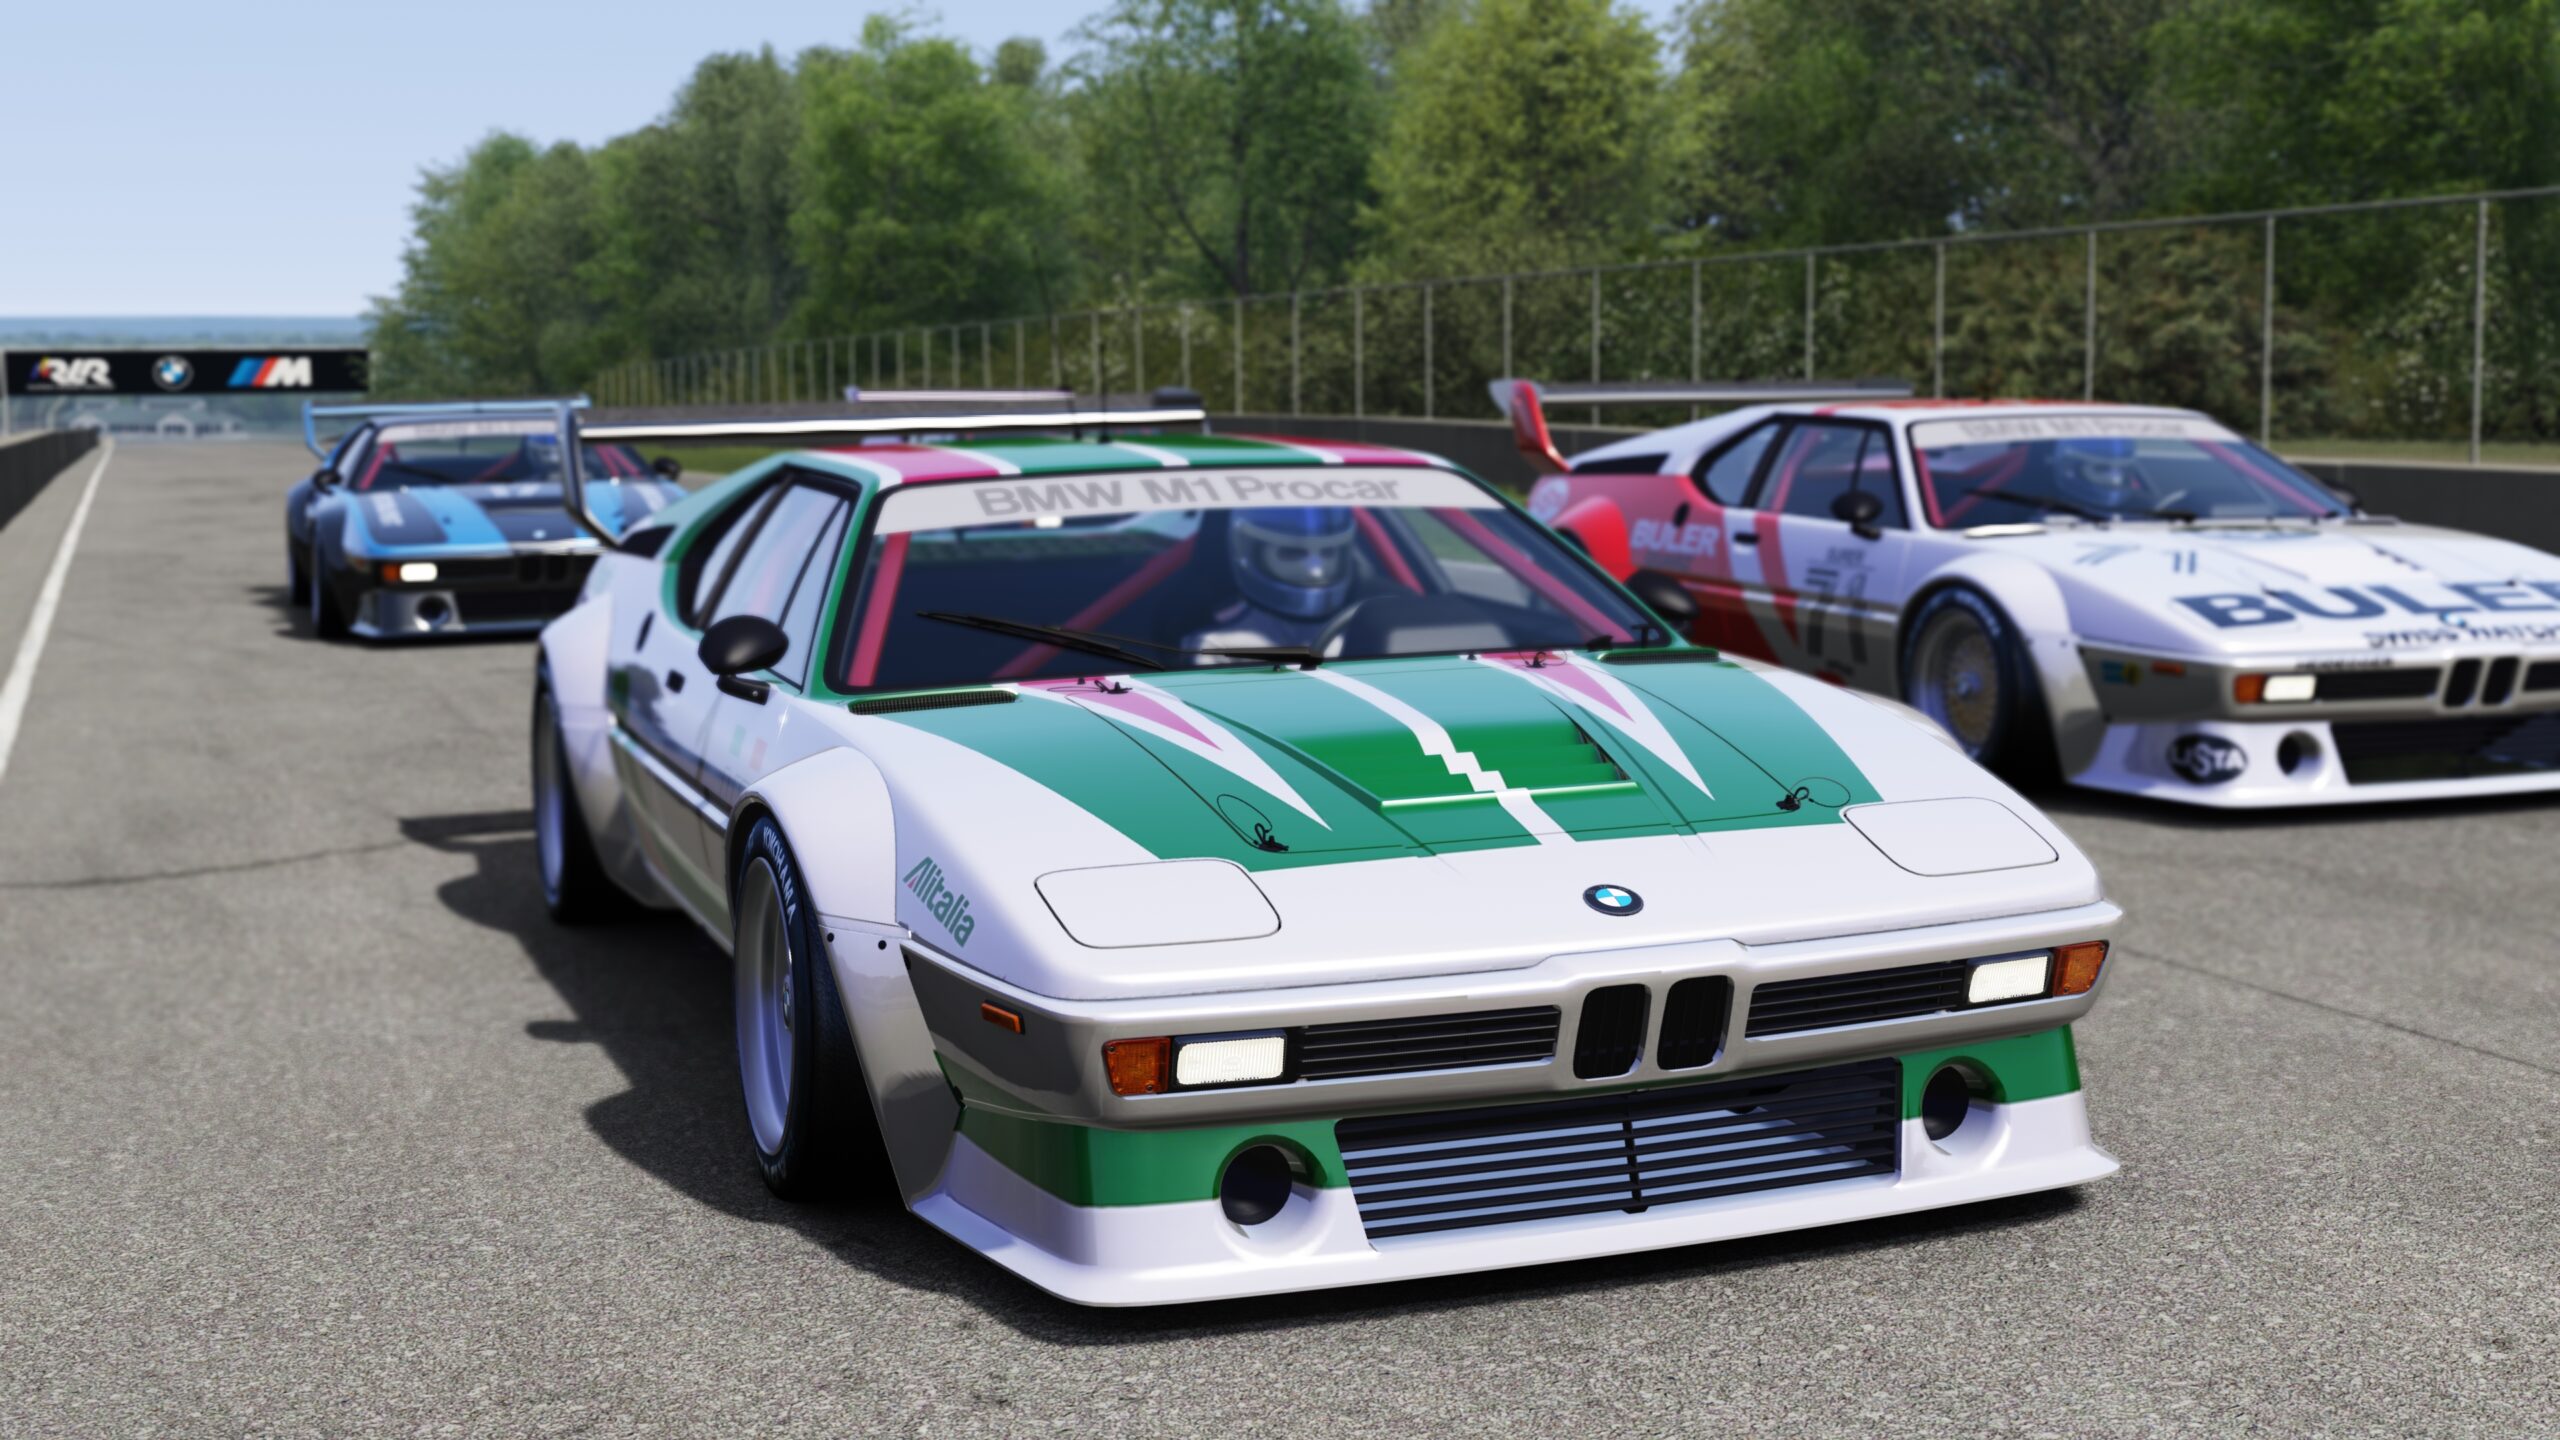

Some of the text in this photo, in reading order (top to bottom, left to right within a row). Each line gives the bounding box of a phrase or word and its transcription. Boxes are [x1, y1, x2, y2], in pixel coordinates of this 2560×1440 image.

[973, 476, 1398, 517] BMW M1 Procar
[1629, 518, 1720, 557] BULER
[763, 826, 797, 926] YOKOHAMA
[902, 856, 975, 948] Alitalia
